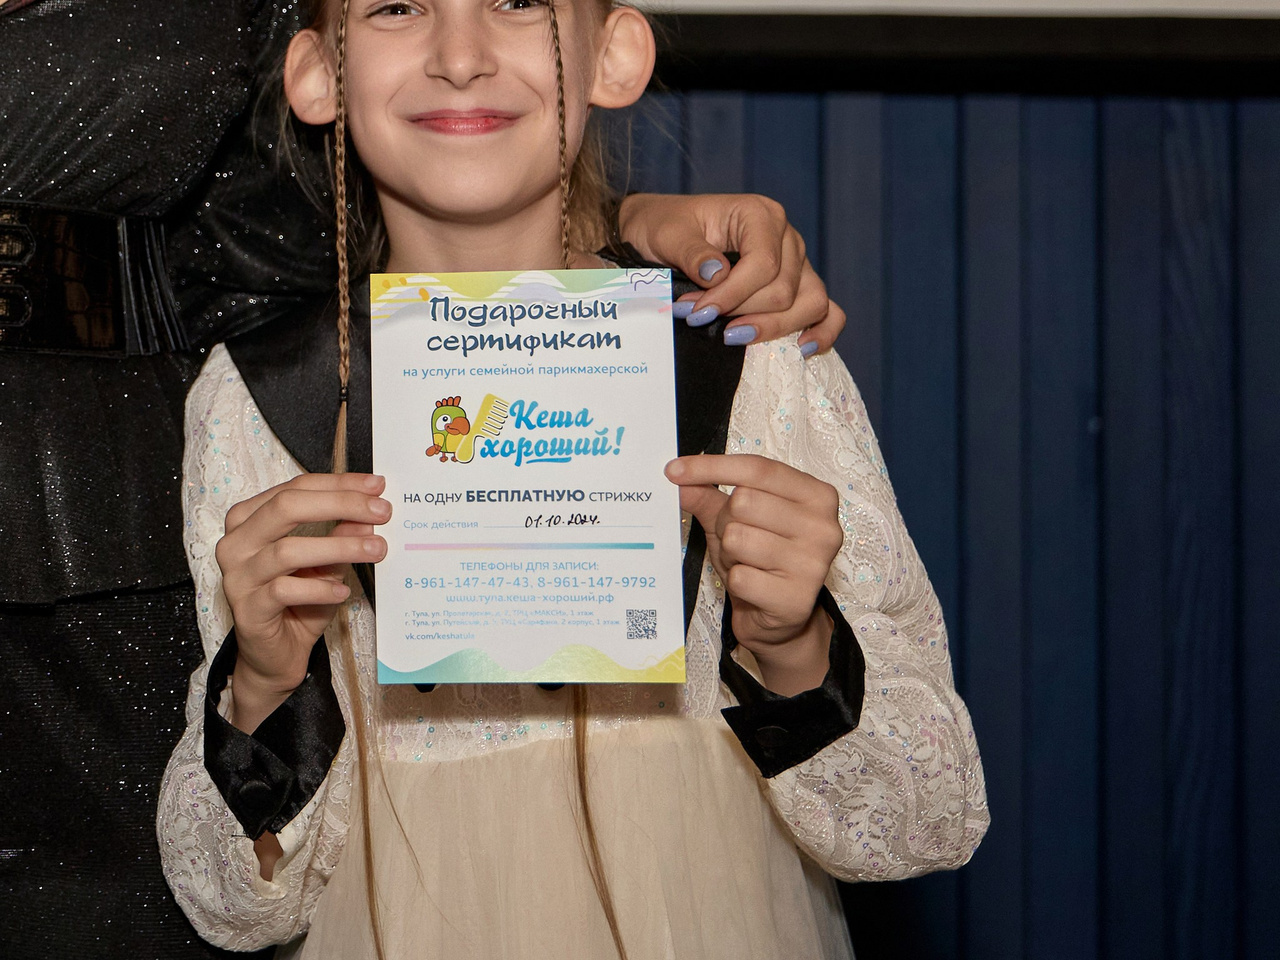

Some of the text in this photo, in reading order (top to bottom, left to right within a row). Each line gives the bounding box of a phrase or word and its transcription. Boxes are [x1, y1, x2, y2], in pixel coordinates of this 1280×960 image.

[430, 295, 619, 327] Подарочный
[426, 330, 622, 357] сертификат
[403, 362, 648, 380] на услуги семейной парикмахерской
[509, 399, 594, 430] Кеша
[480, 426, 626, 467] хороший!
[403, 489, 652, 506] НА ОДНУ БЕСПЛАТНУЮ СТРИЖКУ
[403, 520, 479, 530] Срок действия
[460, 561, 600, 573] ТЕЛЕФОНЫ ДЛЯ ЗАПИСИ:
[537, 576, 657, 588] 8-961-147-9792
